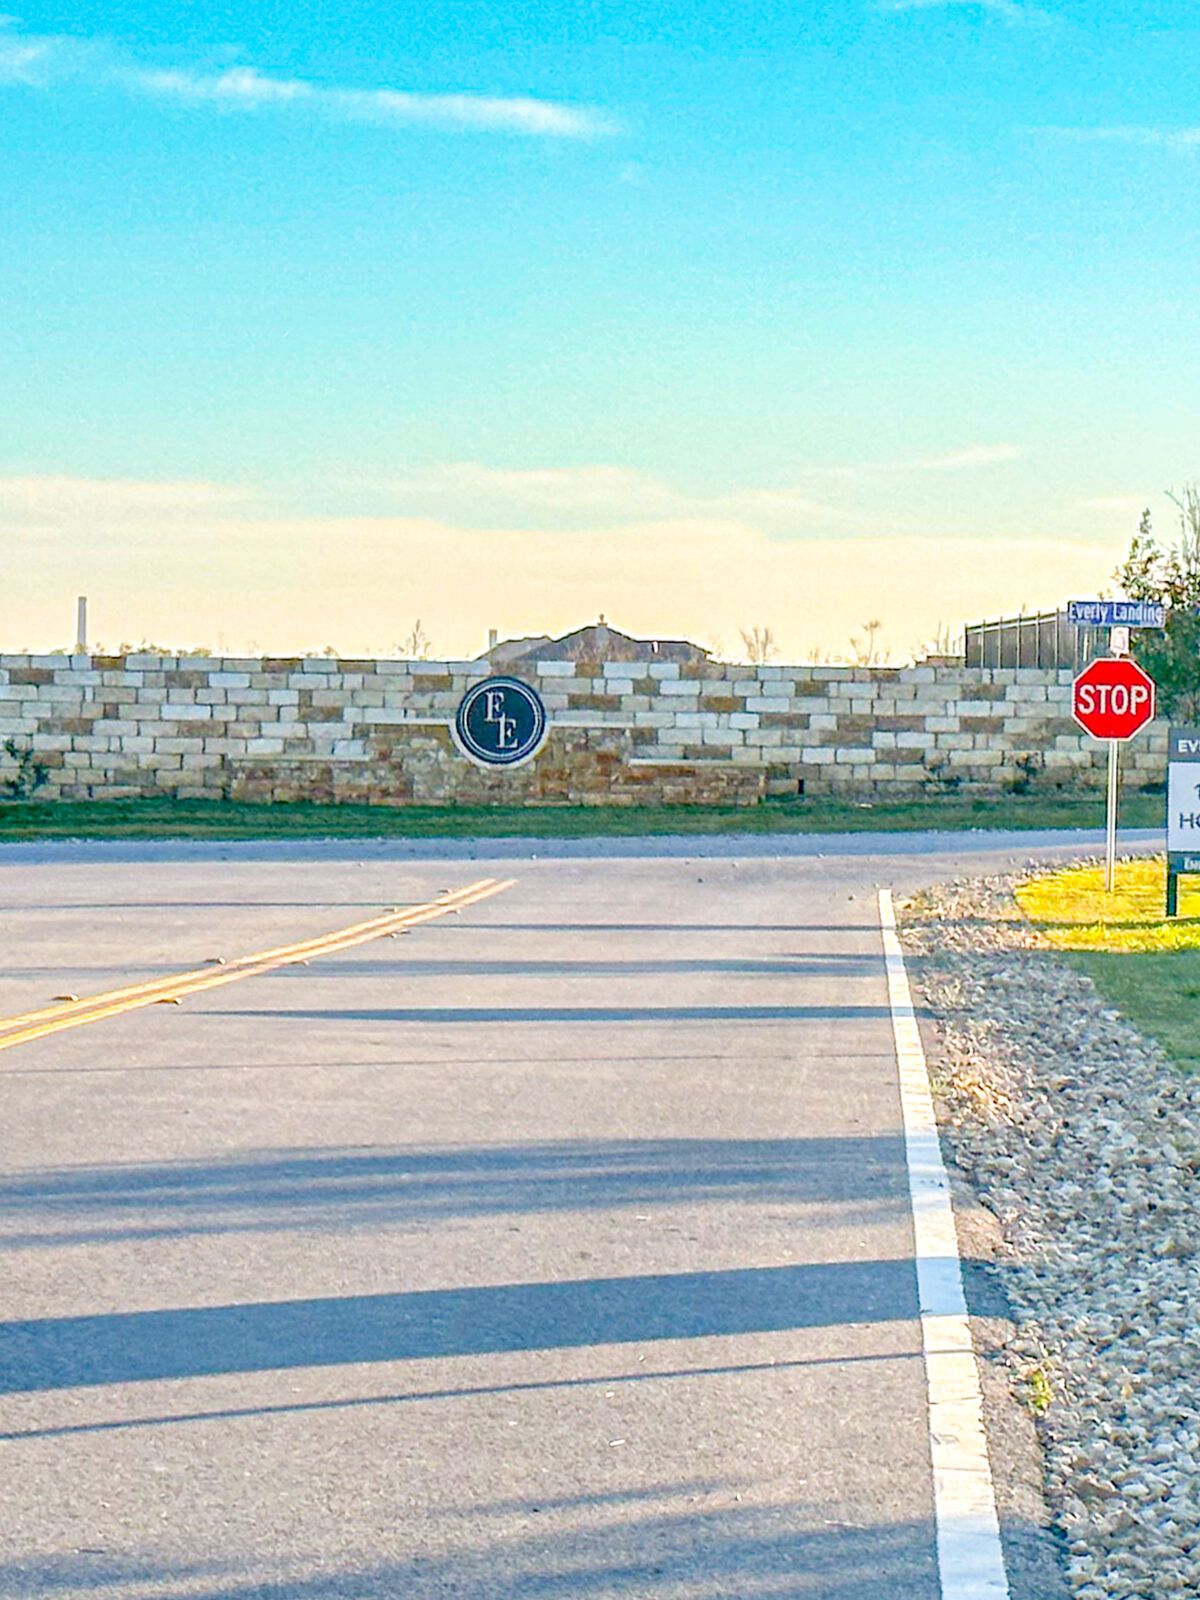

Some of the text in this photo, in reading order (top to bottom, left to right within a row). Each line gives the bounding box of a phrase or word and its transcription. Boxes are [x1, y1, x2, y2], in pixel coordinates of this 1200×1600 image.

[1068, 603, 1163, 625] Everly Landing
[1077, 684, 1149, 715] STOP
